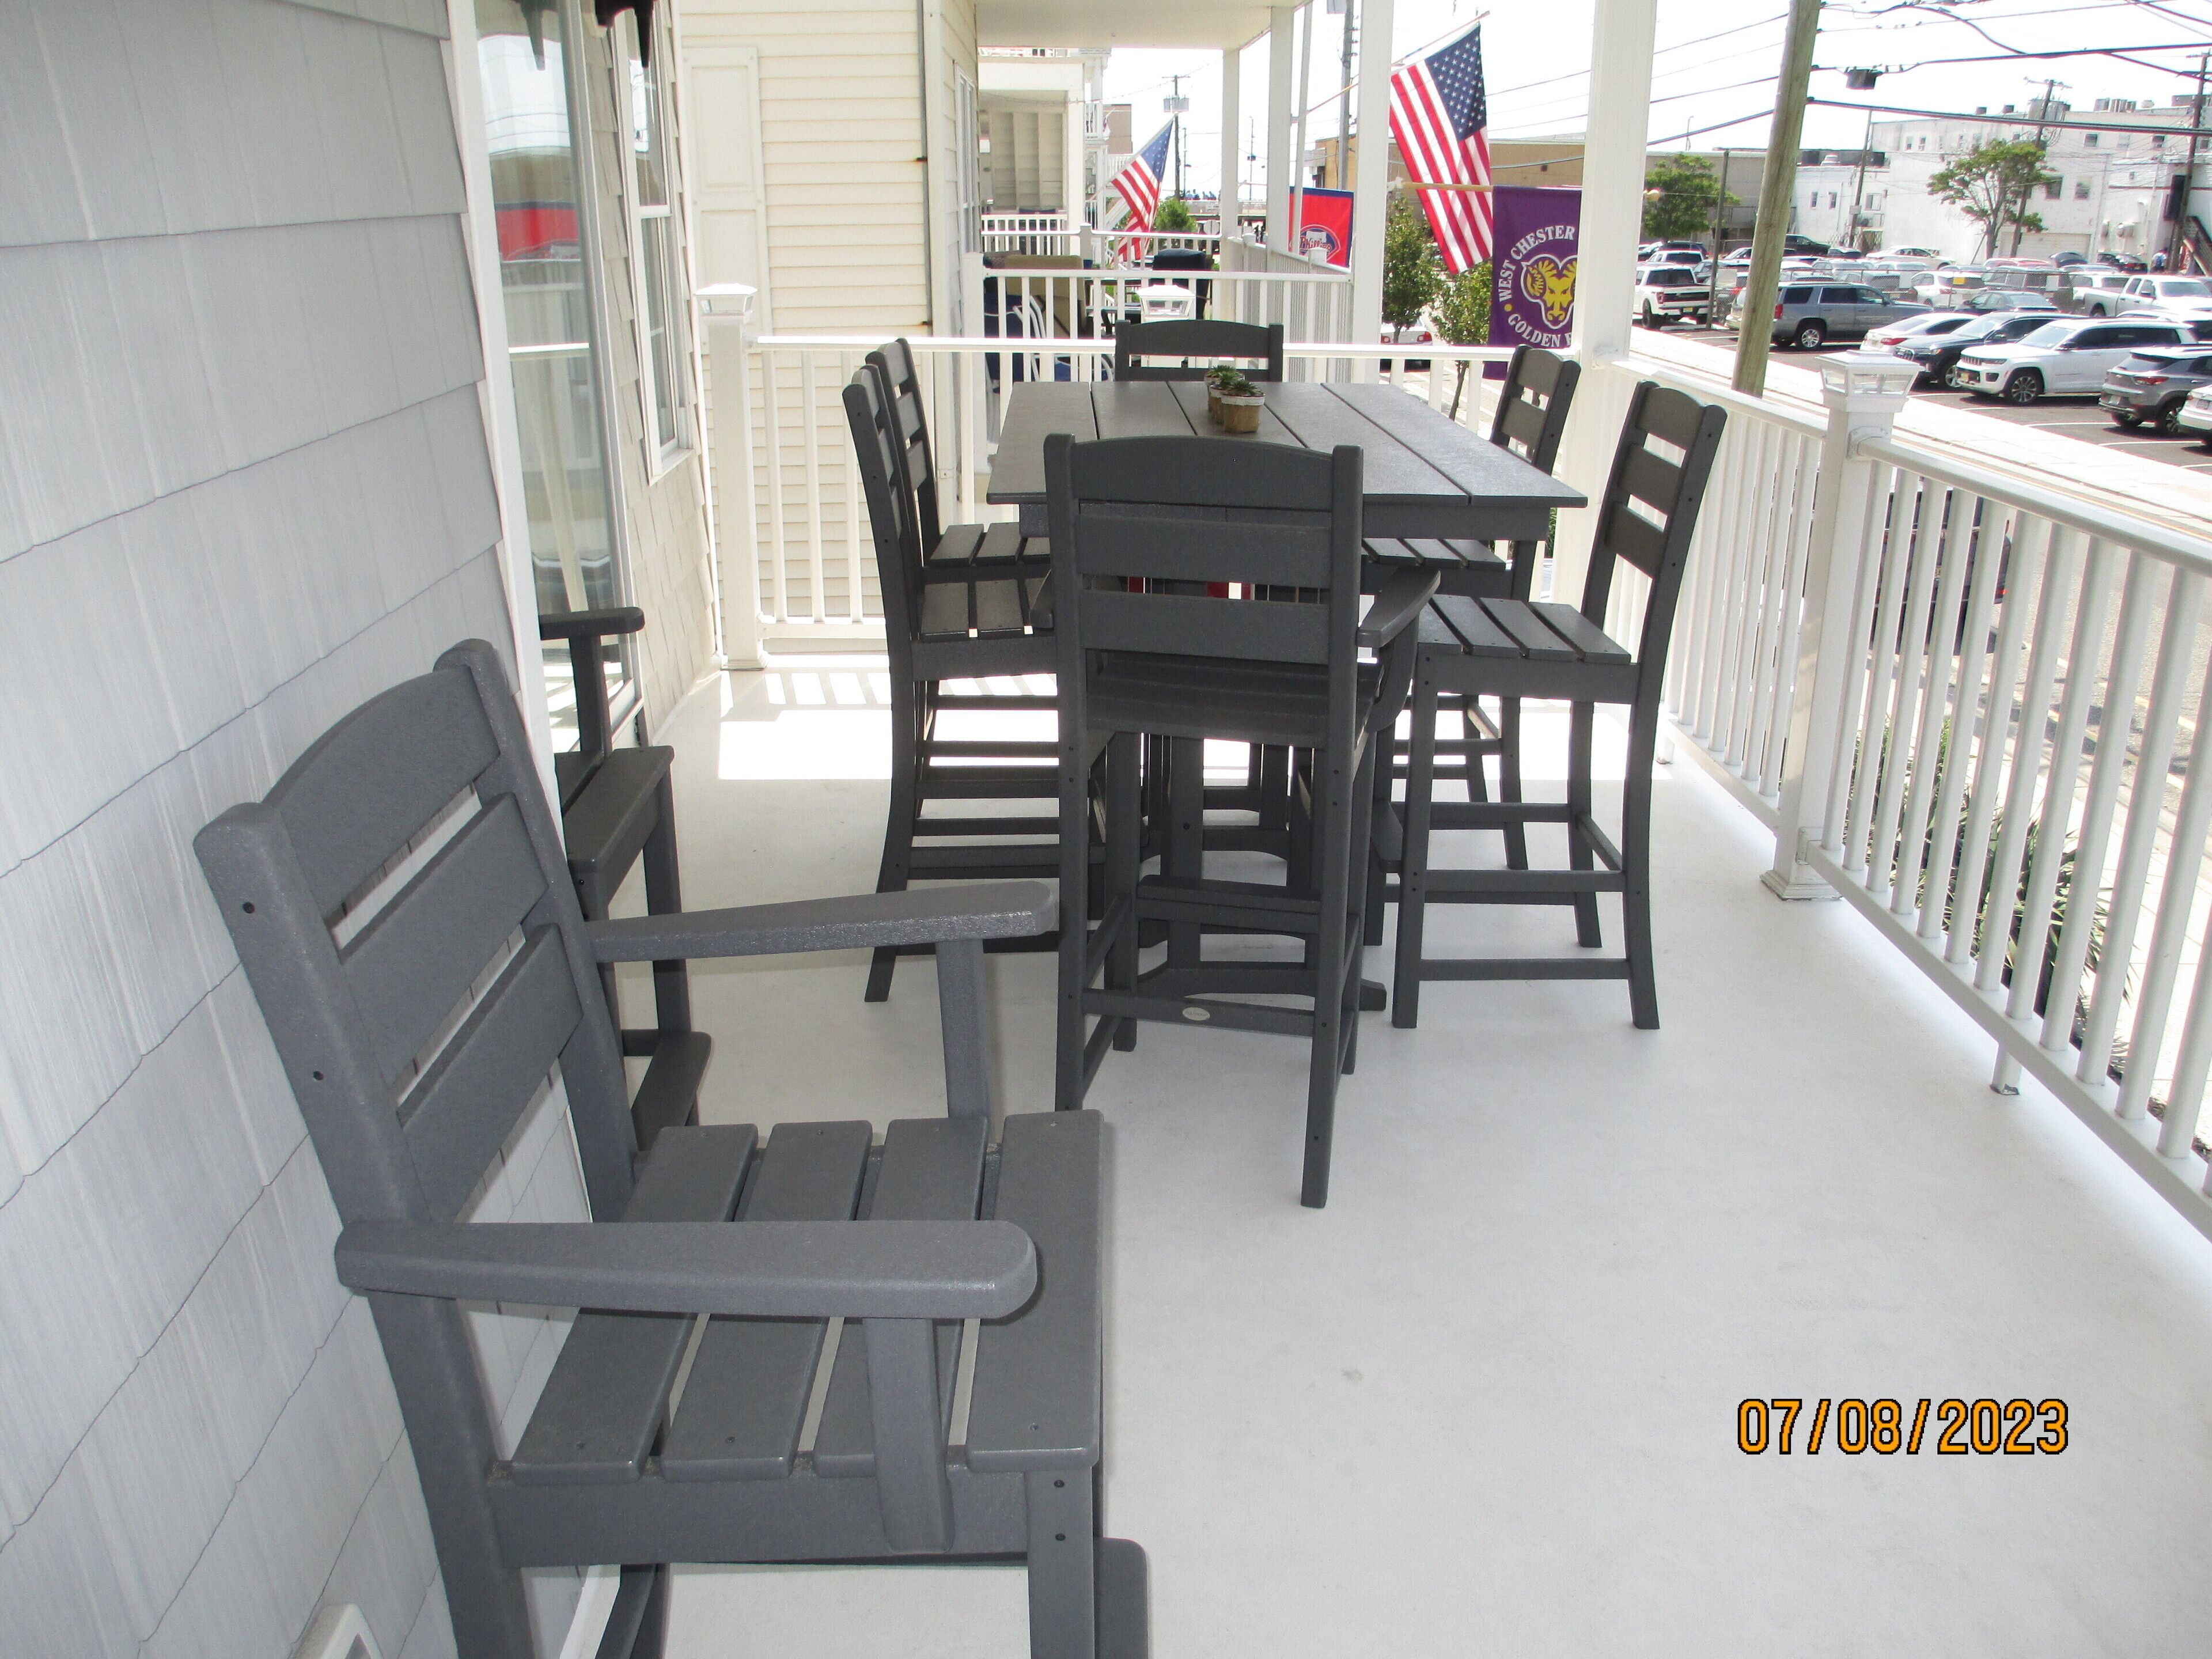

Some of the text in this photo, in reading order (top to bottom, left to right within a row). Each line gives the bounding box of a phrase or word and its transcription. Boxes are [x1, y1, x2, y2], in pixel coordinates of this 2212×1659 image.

[1498, 225, 1575, 302] WEST CHESTER
[1508, 313, 1561, 347] GOLDEN
